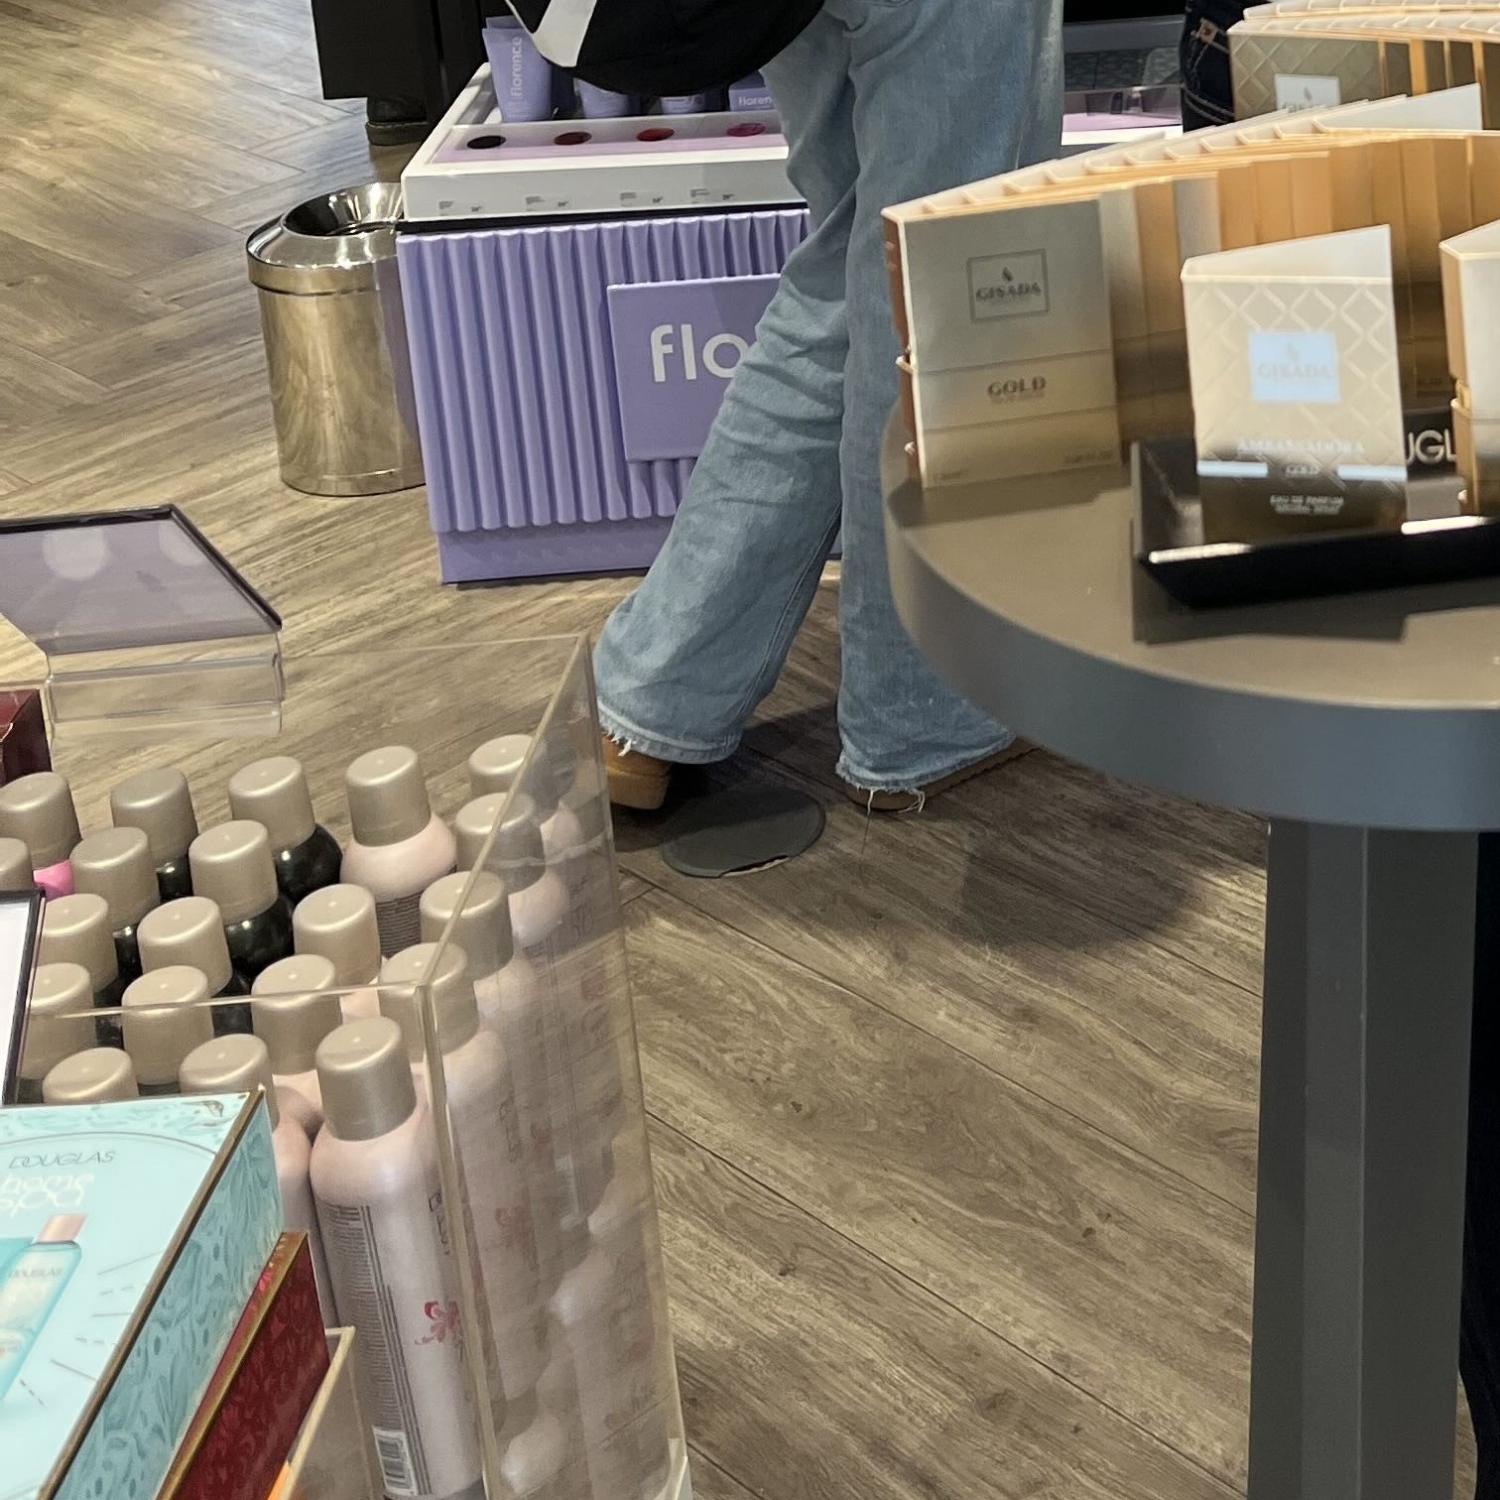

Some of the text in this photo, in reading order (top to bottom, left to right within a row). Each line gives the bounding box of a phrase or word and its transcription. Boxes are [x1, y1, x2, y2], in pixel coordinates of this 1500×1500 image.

[511, 35, 523, 98] florence
[975, 281, 1042, 302] GISADA
[986, 375, 1047, 397] GOLD
[8, 1150, 117, 1170] DOUGLAS
